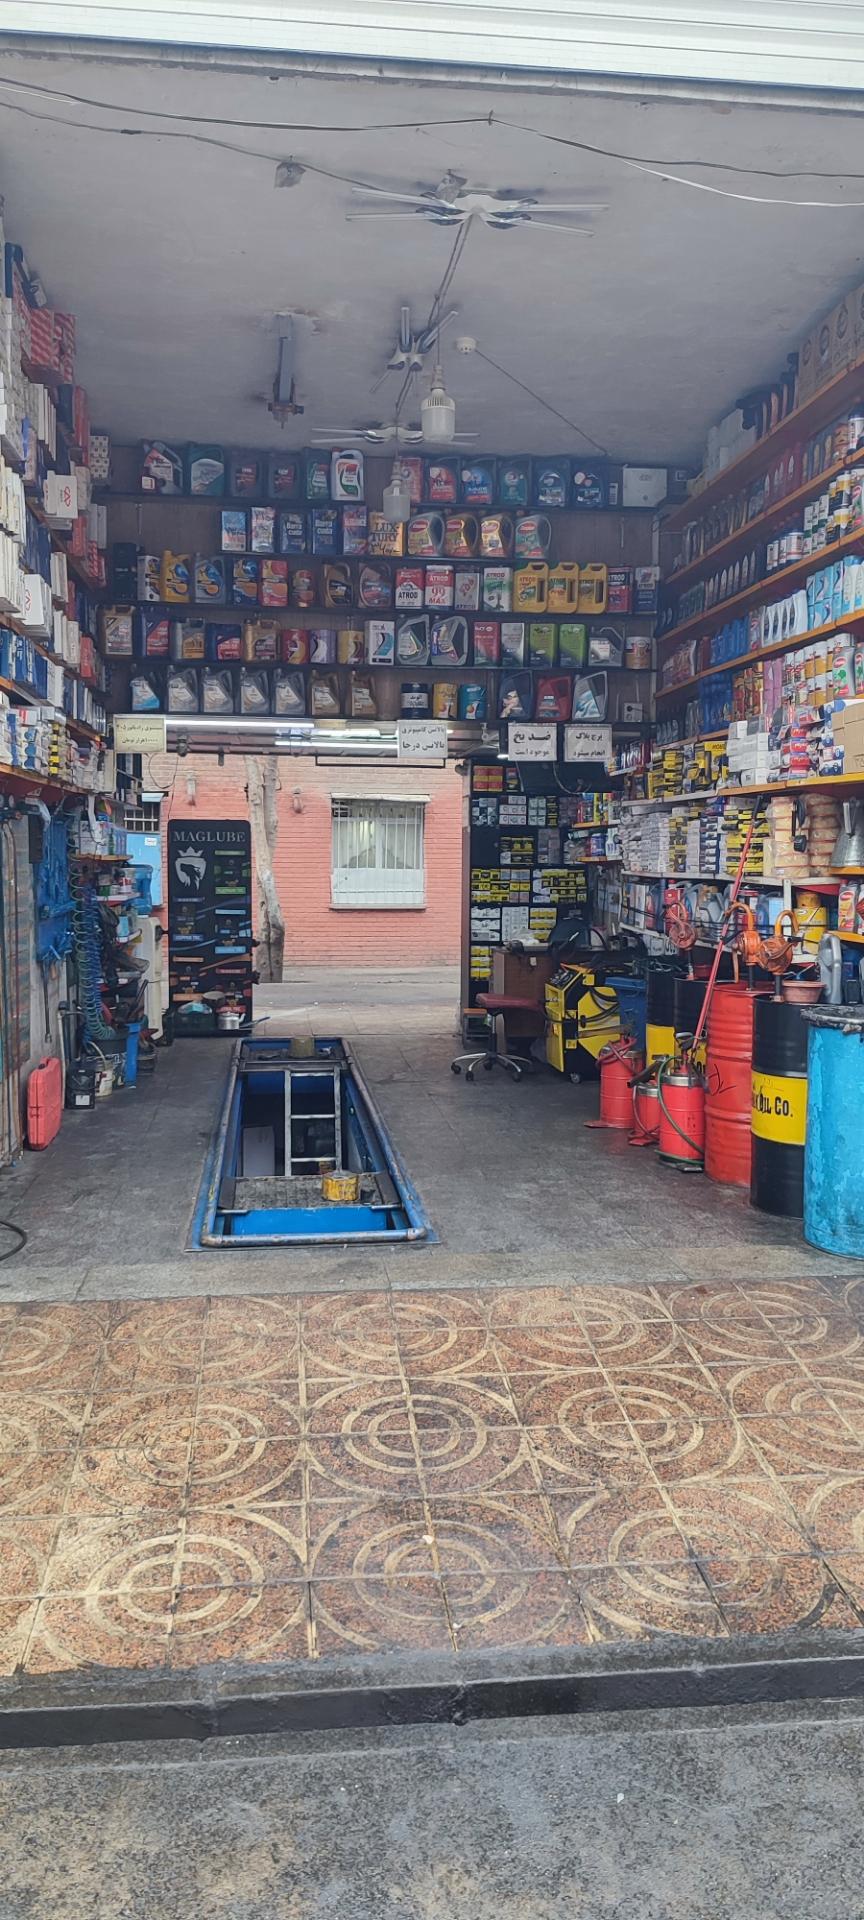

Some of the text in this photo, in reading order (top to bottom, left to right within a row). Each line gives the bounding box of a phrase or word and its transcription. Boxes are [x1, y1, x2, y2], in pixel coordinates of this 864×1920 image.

[398, 591, 419, 599] ATROD
[513, 730, 552, 744] ضد یخ
[173, 830, 246, 843] MAGLUBE
